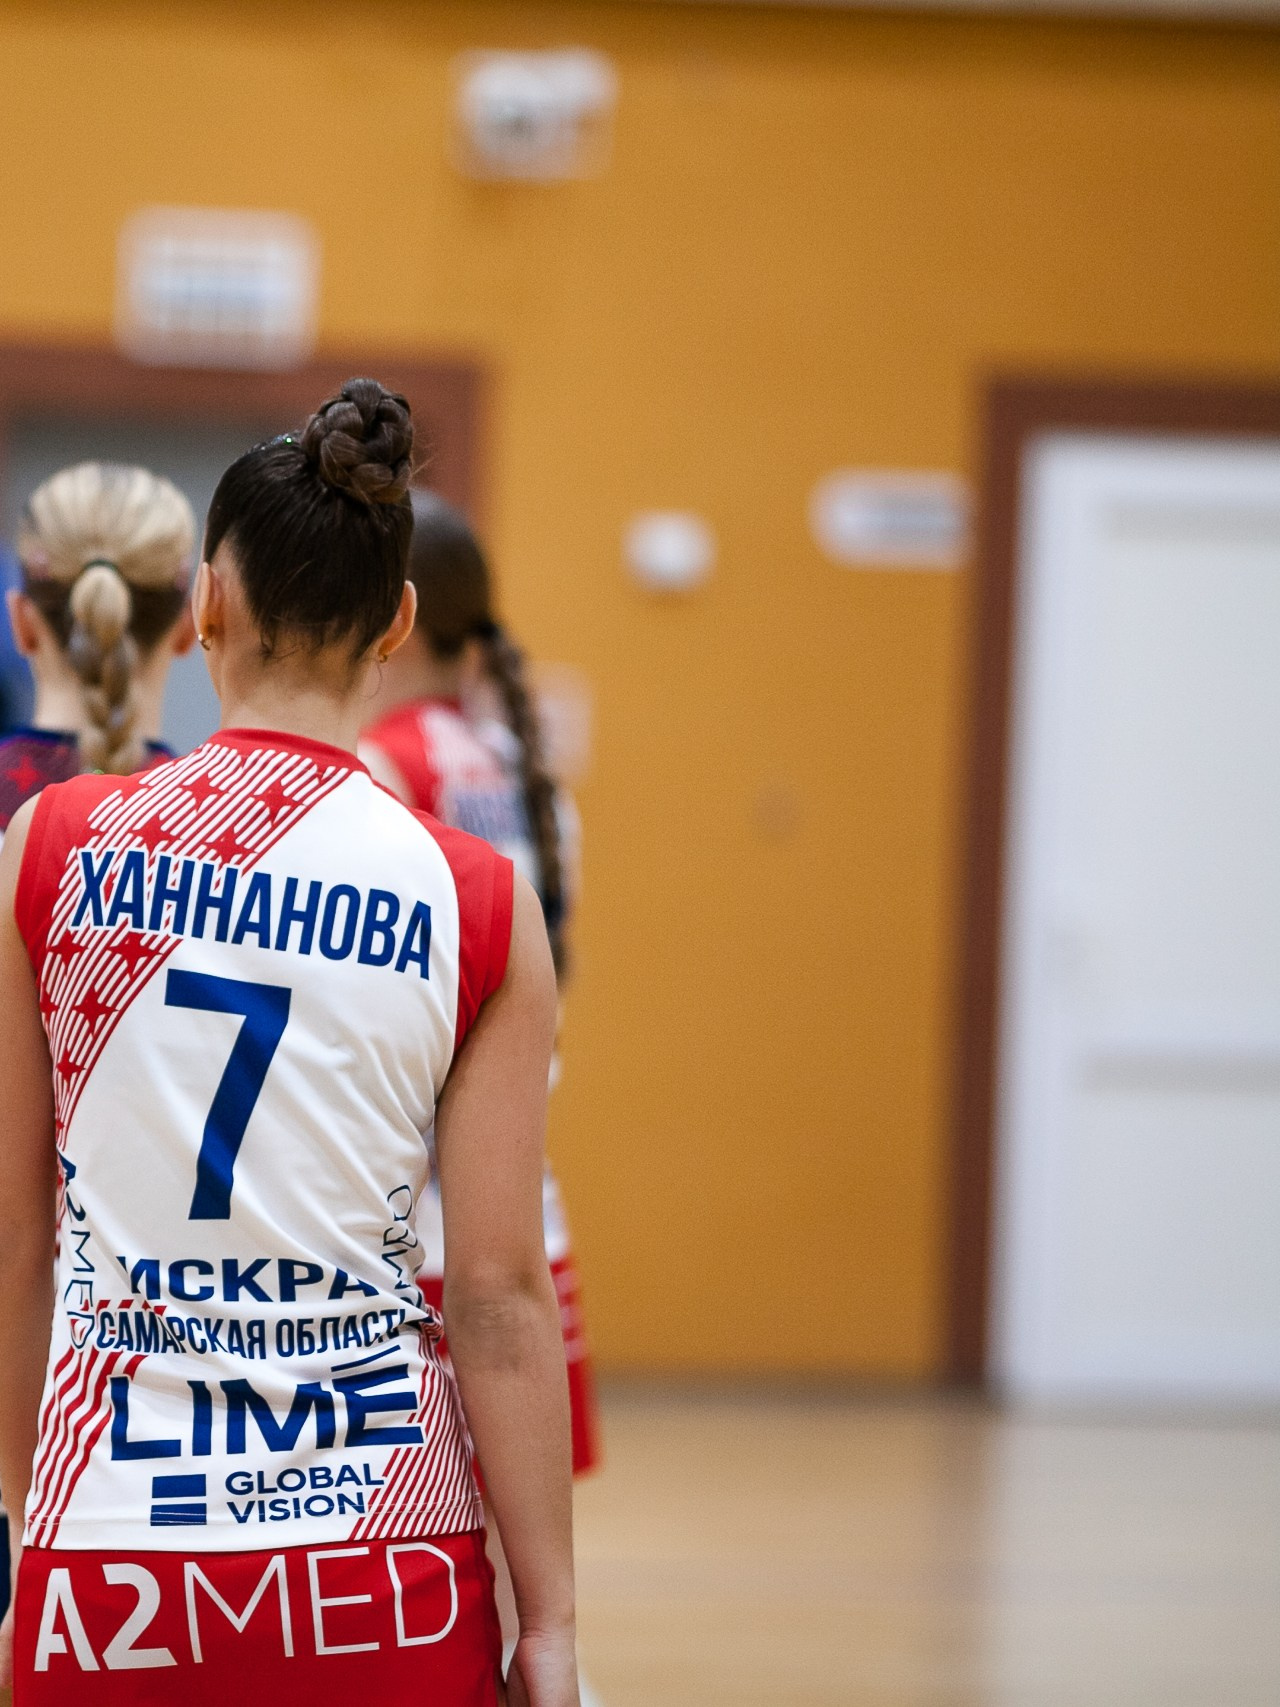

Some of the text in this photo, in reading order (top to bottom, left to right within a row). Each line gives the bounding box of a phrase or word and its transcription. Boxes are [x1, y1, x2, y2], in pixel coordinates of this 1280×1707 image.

[71, 850, 431, 980] ХАННАНОВА
[164, 968, 292, 1221] 7
[116, 1256, 379, 1303] ИСКРА
[96, 1310, 267, 1360] САМАРСКАЯ
[225, 1463, 384, 1497] GLOBAL
[227, 1492, 366, 1525] VISION
[34, 1542, 458, 1671] A2MED
